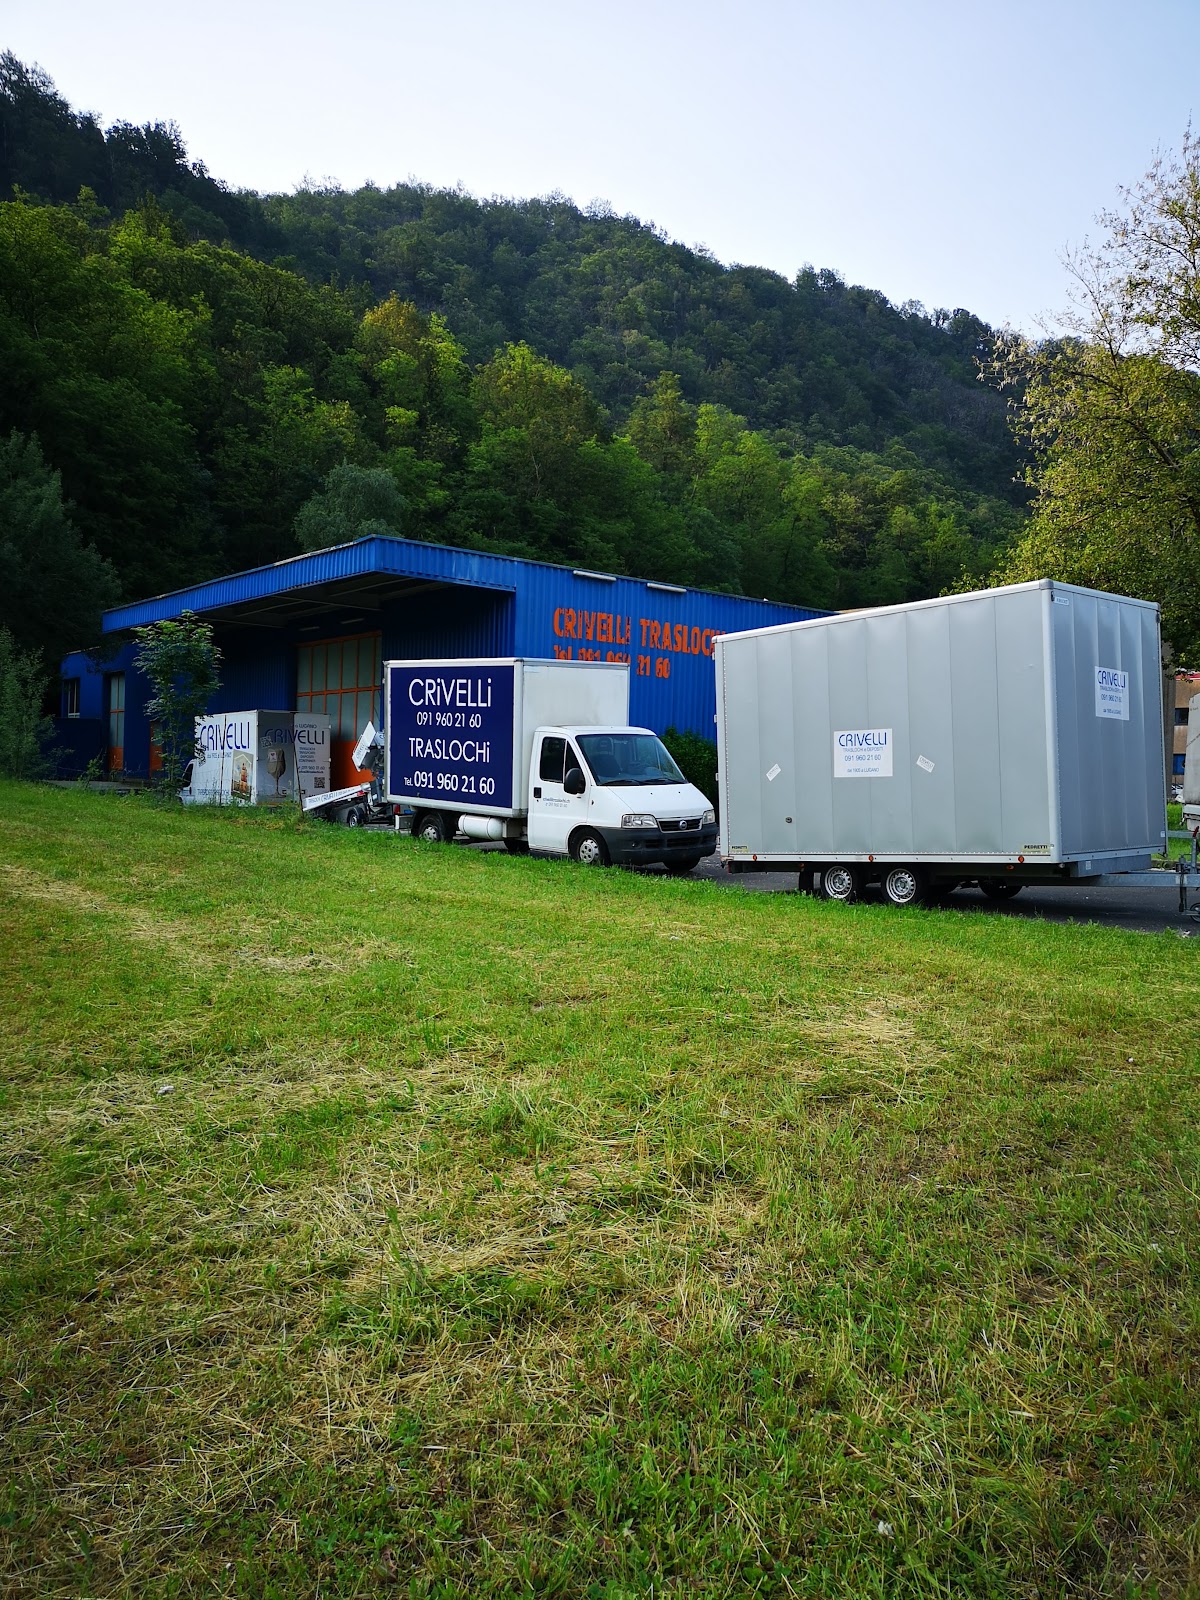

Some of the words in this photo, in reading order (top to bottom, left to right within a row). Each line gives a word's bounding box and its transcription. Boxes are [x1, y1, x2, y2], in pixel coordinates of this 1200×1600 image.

[639, 618, 725, 657] TRASLOC
[637, 655, 651, 677] 21
[655, 656, 671, 679] 60
[1097, 670, 1126, 688] CRIVELLI
[416, 712, 432, 726] 091
[436, 712, 452, 727] 960
[454, 713, 465, 727] 21
[469, 713, 481, 728] 60
[200, 722, 250, 751] CRIVELLI
[264, 728, 325, 745] CRIVELLI
[838, 731, 887, 747] CRIVELLI
[404, 777, 414, 786] Tel.
[414, 771, 434, 789] 091
[437, 772, 458, 792] 960
[461, 775, 476, 793] 21
[479, 777, 495, 795] 60
